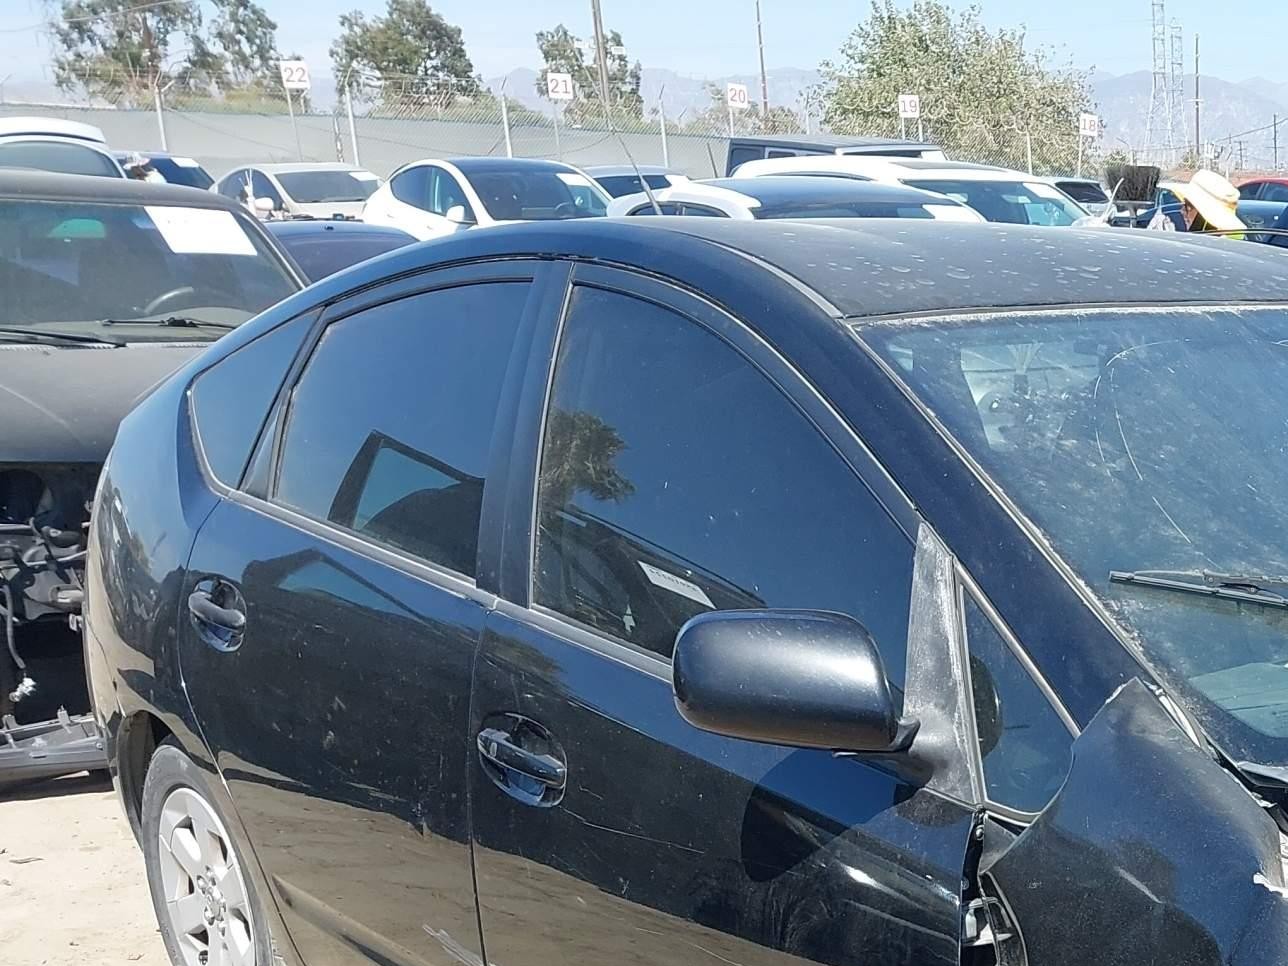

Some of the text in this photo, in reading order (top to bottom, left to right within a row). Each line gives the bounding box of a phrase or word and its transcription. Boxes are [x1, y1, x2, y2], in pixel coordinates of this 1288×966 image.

[284, 67, 307, 83] 22
[550, 79, 571, 94] 21
[730, 88, 746, 104] 20
[900, 100, 917, 113] 19
[1081, 119, 1096, 131] 18
